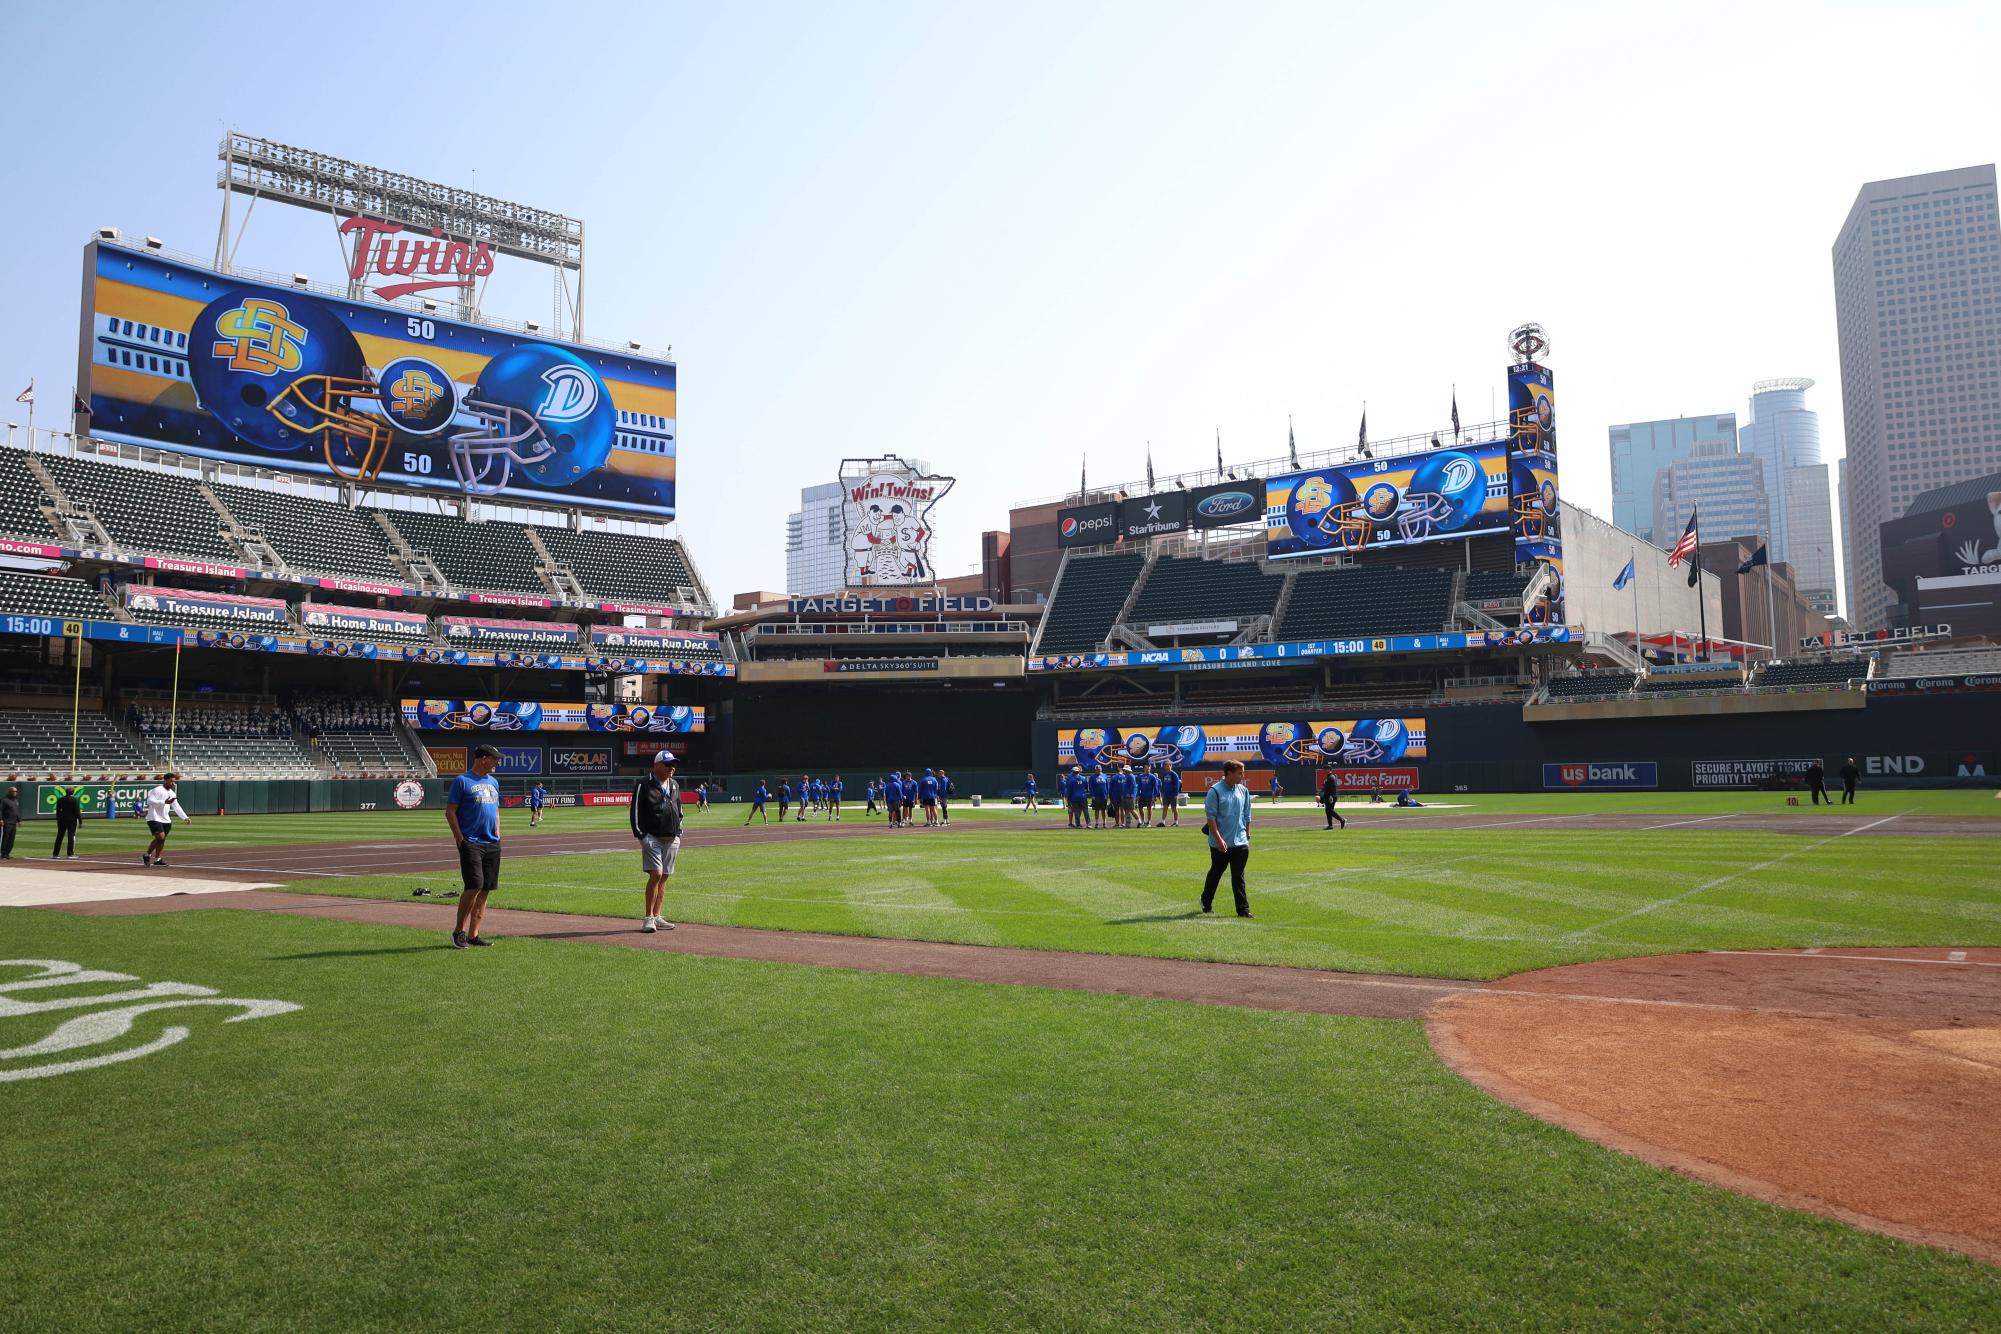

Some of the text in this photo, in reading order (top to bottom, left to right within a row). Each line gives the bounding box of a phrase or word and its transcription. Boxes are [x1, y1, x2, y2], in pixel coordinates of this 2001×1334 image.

[340, 217, 494, 280] Twins
[407, 317, 435, 340] 50
[404, 452, 432, 473] 50
[1374, 461, 1388, 472] 50
[851, 480, 934, 502] Win! Twins!
[1208, 495, 1242, 514] Ford
[1079, 514, 1112, 533] pepsi
[1129, 520, 1180, 535] StarTribune
[1377, 529, 1391, 541] 50
[156, 560, 236, 577] Treasure Island
[479, 595, 543, 607] Treasure Island
[791, 597, 994, 612] TARGET FIELD
[166, 600, 275, 620] Treasure Island
[7, 616, 52, 635] 15:00
[66, 624, 80, 634] 40
[331, 616, 423, 634] Home Run Deck
[120, 627, 129, 638] &
[478, 628, 567, 642] Treasure Island
[1803, 623, 1951, 647] TAGET FIELD
[629, 636, 709, 650] Home Run Deck
[1333, 641, 1364, 654] 15:00
[1374, 641, 1384, 650] 40
[1414, 638, 1421, 648] &
[1141, 652, 1169, 663] NCAA
[1219, 648, 1226, 660] 0
[1278, 645, 1285, 657] 0
[1189, 659, 1281, 671] TREASURE ISLAND COVE
[1868, 680, 1905, 692] Corona
[1915, 678, 1954, 690] Corona
[437, 760, 465, 770] eerios
[1695, 763, 1732, 774] SECURE
[1734, 762, 1774, 773] PLAYOFF
[1866, 756, 1925, 774] END
[1563, 764, 1636, 781] us bank
[1378, 773, 1411, 786] Farm
[1696, 774, 1739, 785] PRIORITY
[561, 796, 576, 804] FUND
